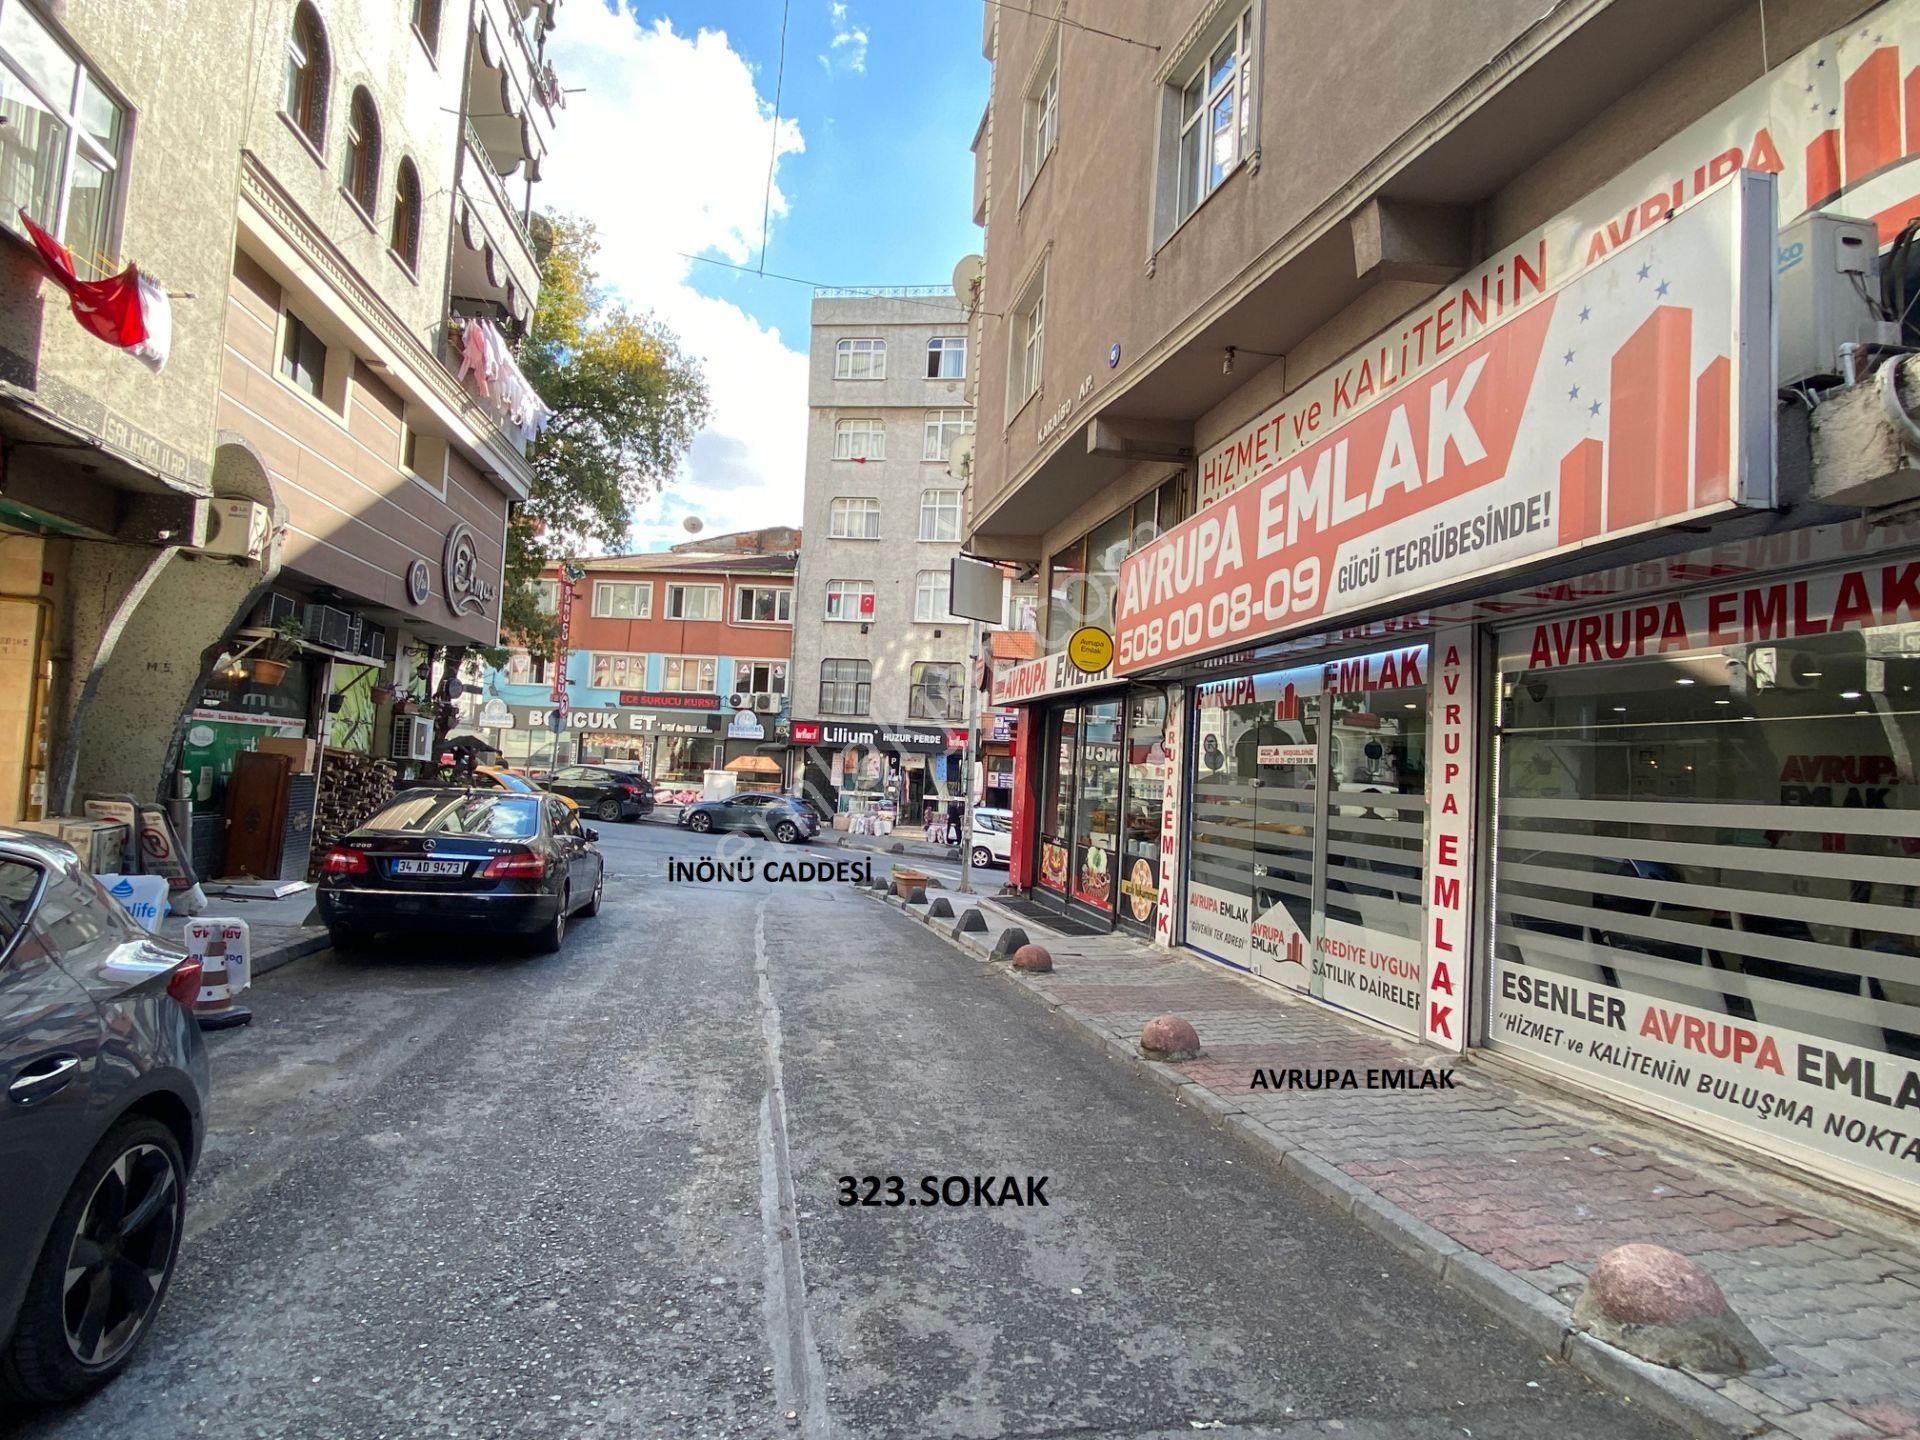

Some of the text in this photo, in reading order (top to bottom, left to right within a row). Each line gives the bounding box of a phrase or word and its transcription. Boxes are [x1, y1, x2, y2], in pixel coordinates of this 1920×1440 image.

[1292, 401, 1322, 440] ve
[1121, 351, 1490, 620] AVRUPA EMLAK
[1337, 490, 1551, 594] GÜCÜ TECRÜBESİNDE!
[1118, 618, 1163, 667] 508
[1166, 609, 1201, 652] 00
[1207, 555, 1321, 636] 08-09
[1528, 601, 1691, 669] AVRUPA
[1707, 560, 1920, 648] EMLAK
[1004, 661, 1048, 698] AVRUPA
[1196, 649, 1423, 710] AVRUPA EMLAK
[529, 710, 619, 730] BCUK
[629, 714, 657, 731] ET
[823, 726, 941, 745] Lilium HUZUR PERDE
[1441, 645, 1462, 815] AVRUPA
[400, 860, 460, 874] 34 AD 9473
[1157, 809, 1174, 935] EMLAK
[1190, 891, 1248, 924] AVRUPA EMLAK
[1213, 929, 1223, 942] TEK
[1251, 922, 1285, 945] AVRUPA
[1251, 937, 1278, 957] EMLAK
[1430, 834, 1461, 1041] EMLAK
[1312, 958, 1356, 989] SATILIK
[1316, 935, 1420, 983] KREDİYE UYGUN
[1501, 970, 1627, 1032] ESENLER
[1640, 1005, 1785, 1077] AVRUPA
[1567, 1037, 1584, 1055] ve
[1588, 1039, 1691, 1089] KALİTENİN
[1697, 1073, 1814, 1129] BULUŞMA
